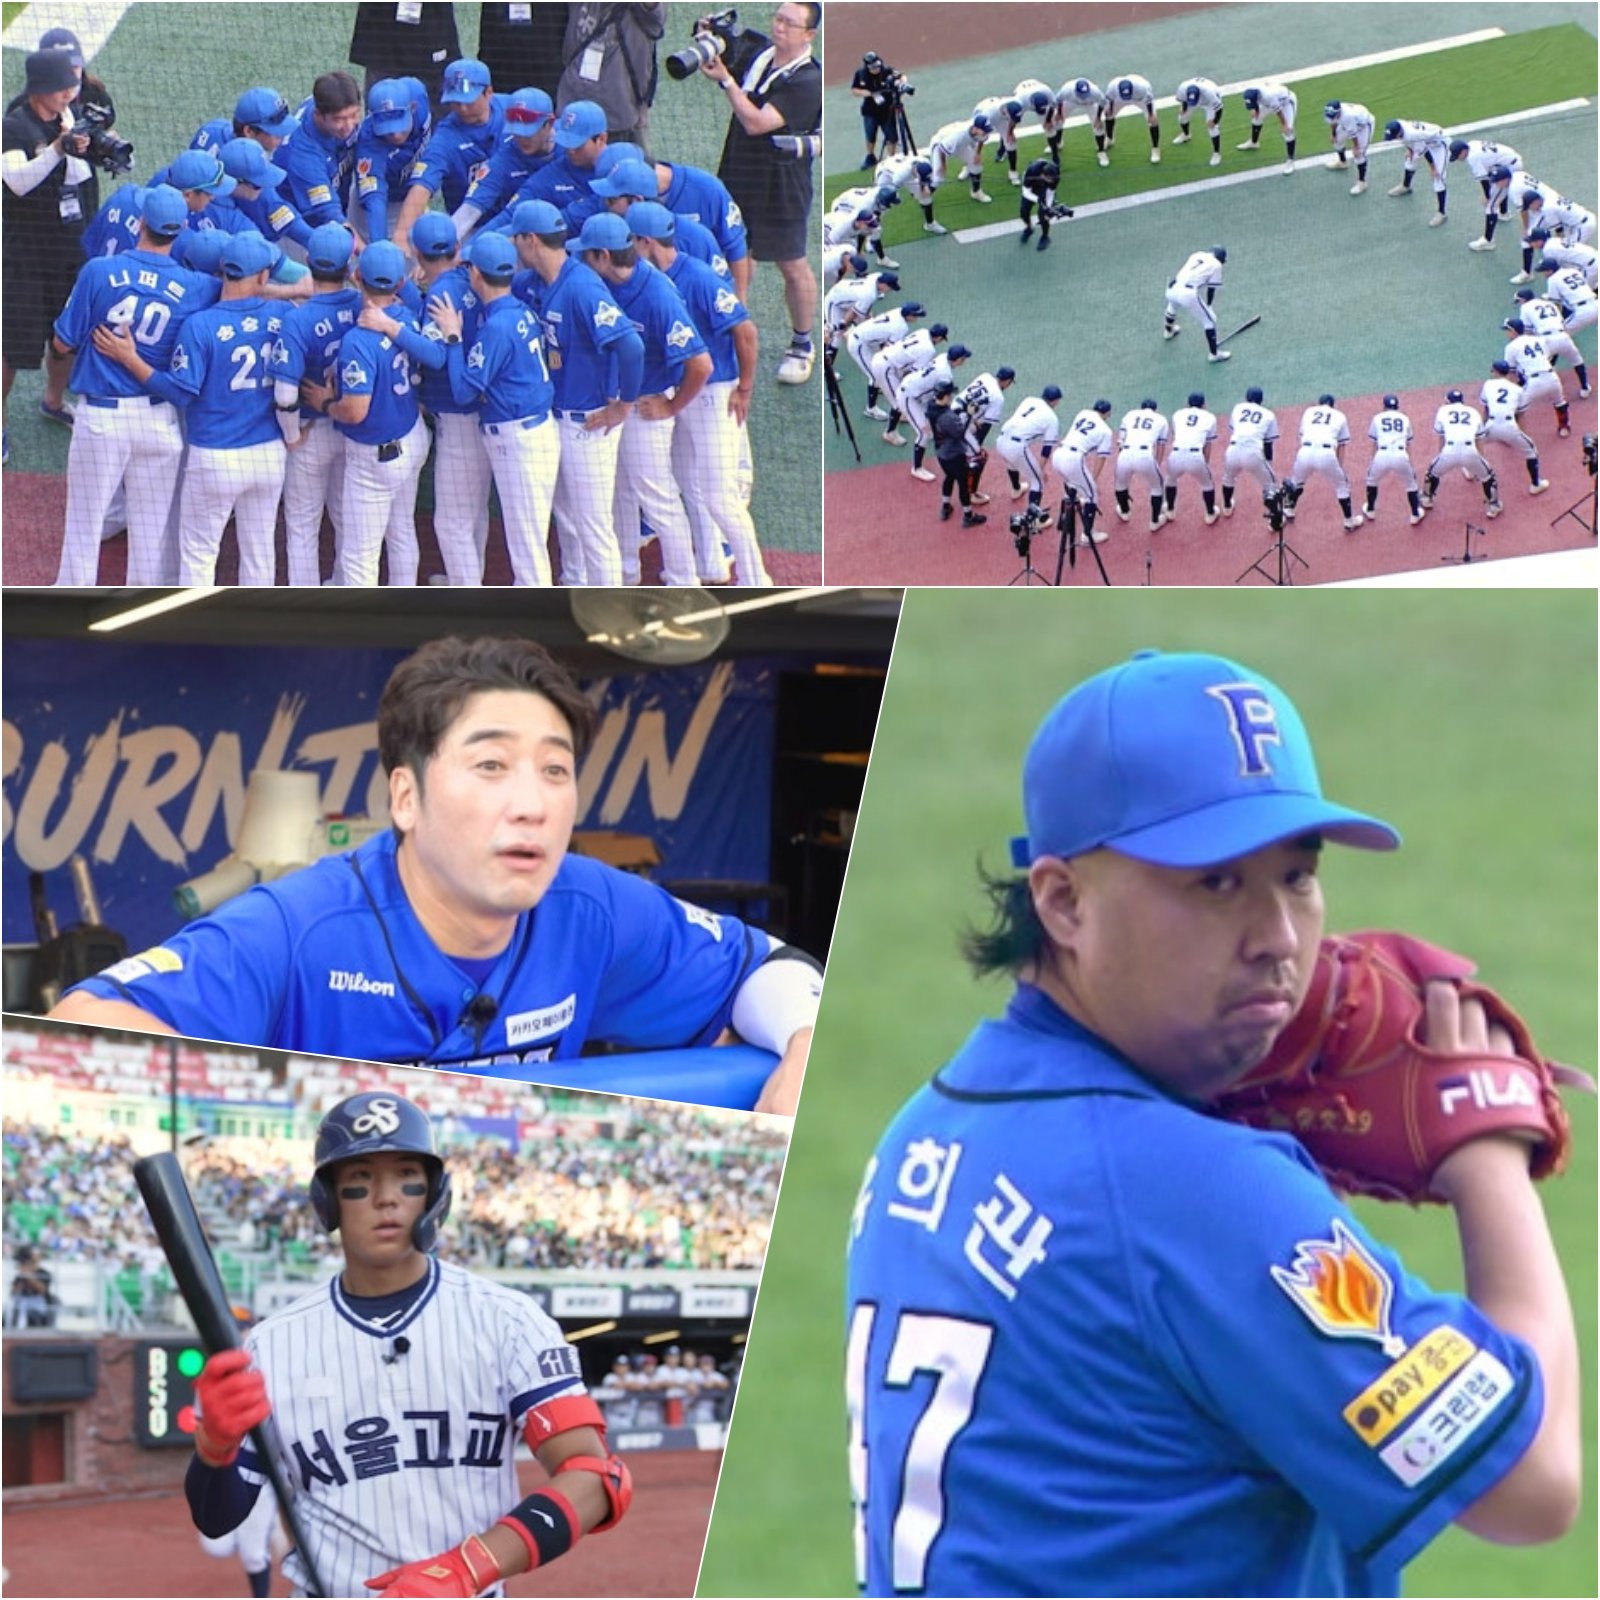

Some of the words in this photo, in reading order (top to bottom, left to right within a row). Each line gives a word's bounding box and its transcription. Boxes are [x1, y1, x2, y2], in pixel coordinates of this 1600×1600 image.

[1563, 273, 1586, 290] 55
[1534, 304, 1557, 319] 23
[107, 294, 171, 346] 40
[1523, 342, 1545, 358] 44
[1496, 388, 1509, 404] 2
[1021, 406, 1036, 419] 1
[1186, 414, 1199, 427] 9
[1239, 409, 1263, 424] 20
[1311, 411, 1332, 425] 21
[1448, 411, 1471, 425] 32
[1074, 417, 1096, 436] 42
[1132, 416, 1153, 430] 16
[1380, 417, 1404, 433] 58
[328, 969, 396, 998] Wilson
[1439, 1070, 1536, 1115] FILA
[1376, 1362, 1425, 1416] pay
[1427, 1370, 1500, 1445] 크린랩
[291, 1410, 508, 1493] 서울고교
